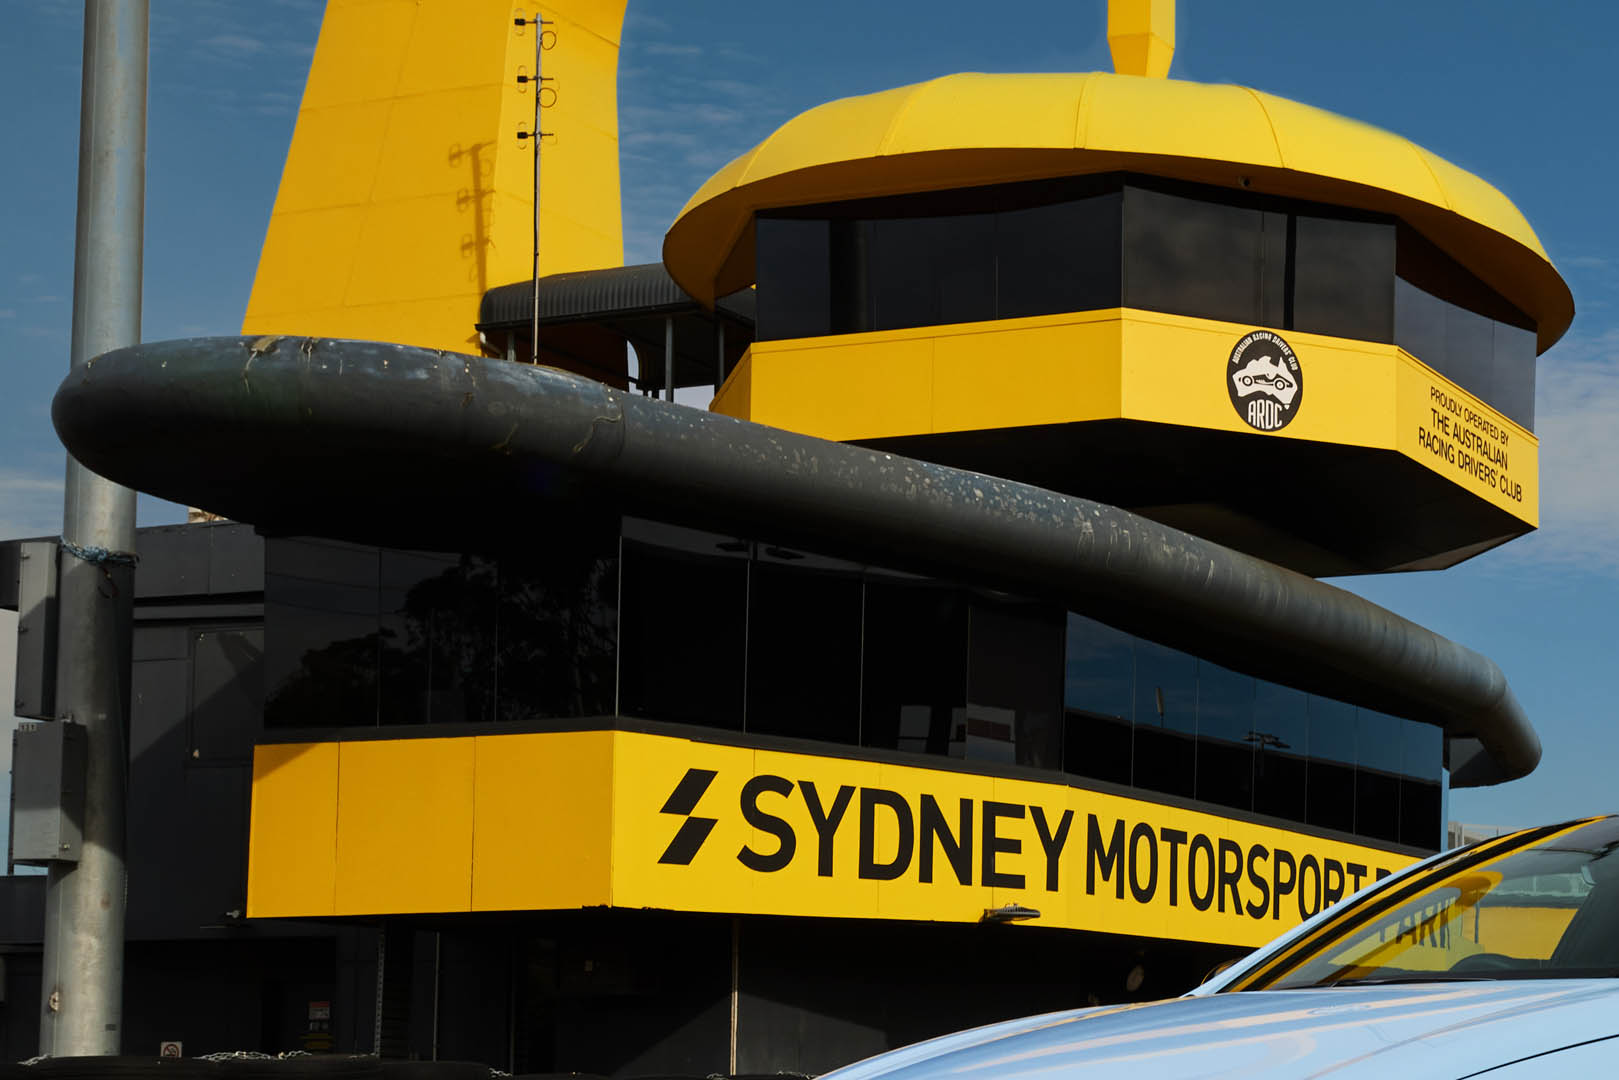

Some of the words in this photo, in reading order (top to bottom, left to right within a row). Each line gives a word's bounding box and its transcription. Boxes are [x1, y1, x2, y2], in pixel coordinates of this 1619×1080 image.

[1248, 399, 1282, 430] ARDC
[1430, 386, 1463, 414] PROUDLY
[1464, 408, 1499, 439] OPERATED
[1500, 430, 1510, 447] BY
[1431, 408, 1451, 437] THE
[1452, 424, 1509, 470] AUSTRALIAN
[1418, 426, 1456, 464] RACING
[1458, 451, 1499, 488] DRIVERS'
[1500, 475, 1523, 503] CLUB
[736, 774, 1075, 893] SYDNEY
[1086, 813, 1367, 920] MOTORSPORT
